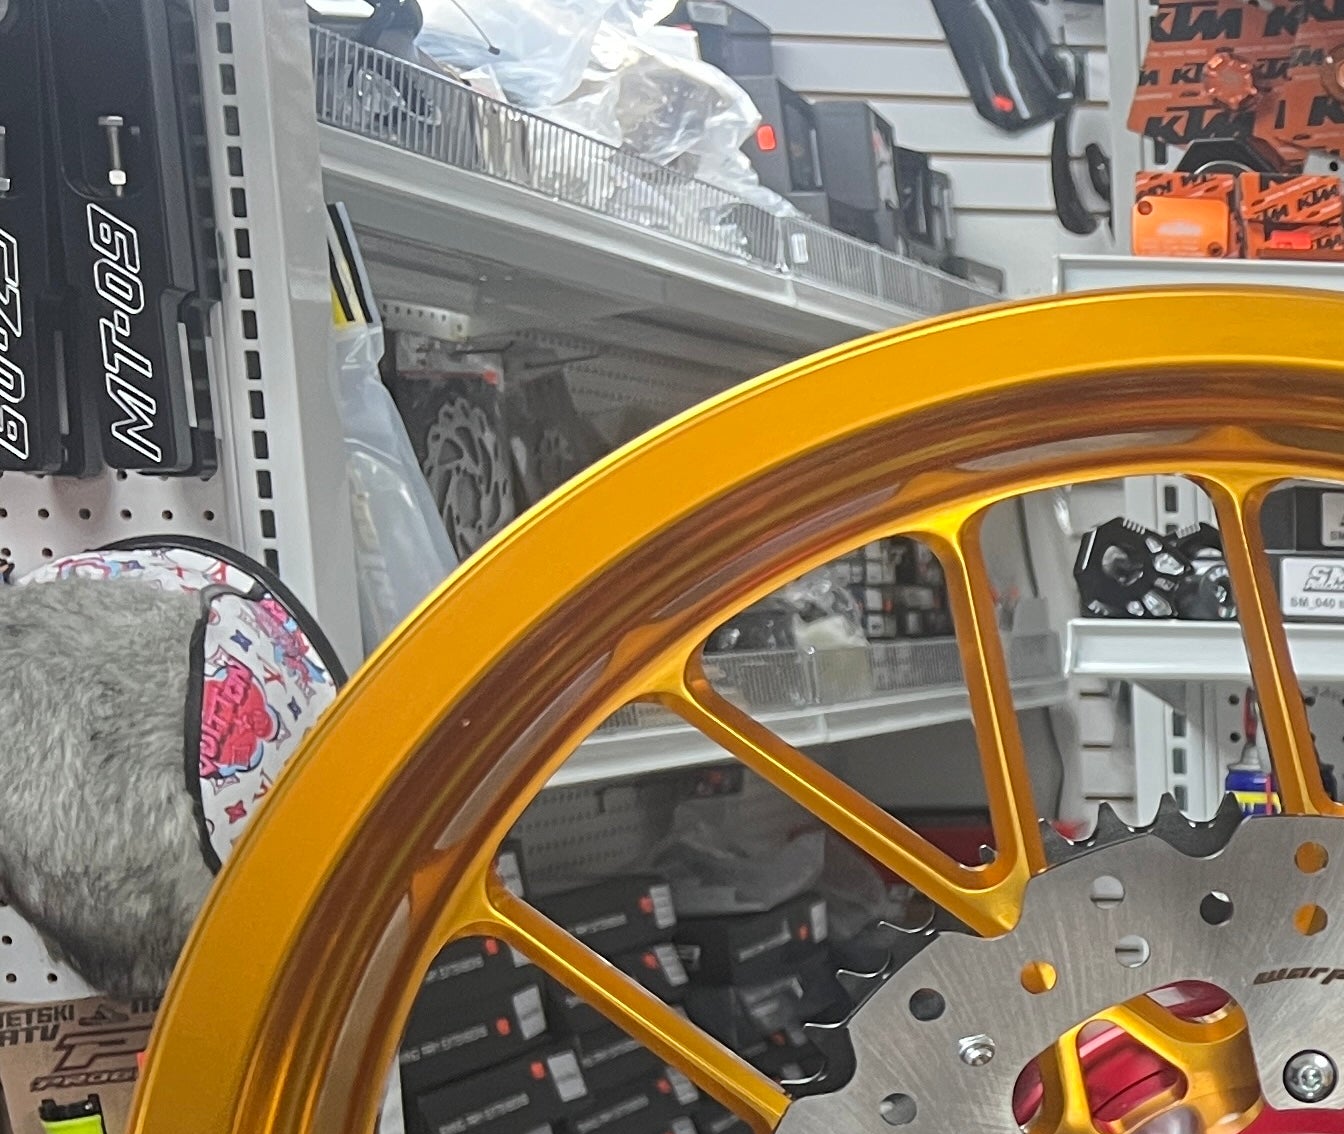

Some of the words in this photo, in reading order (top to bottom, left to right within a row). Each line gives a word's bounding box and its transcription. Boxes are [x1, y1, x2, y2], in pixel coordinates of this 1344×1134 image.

[1297, 184, 1341, 211] KTM
[87, 202, 163, 463] MT-09
[0, 1024, 60, 1047] ATV
